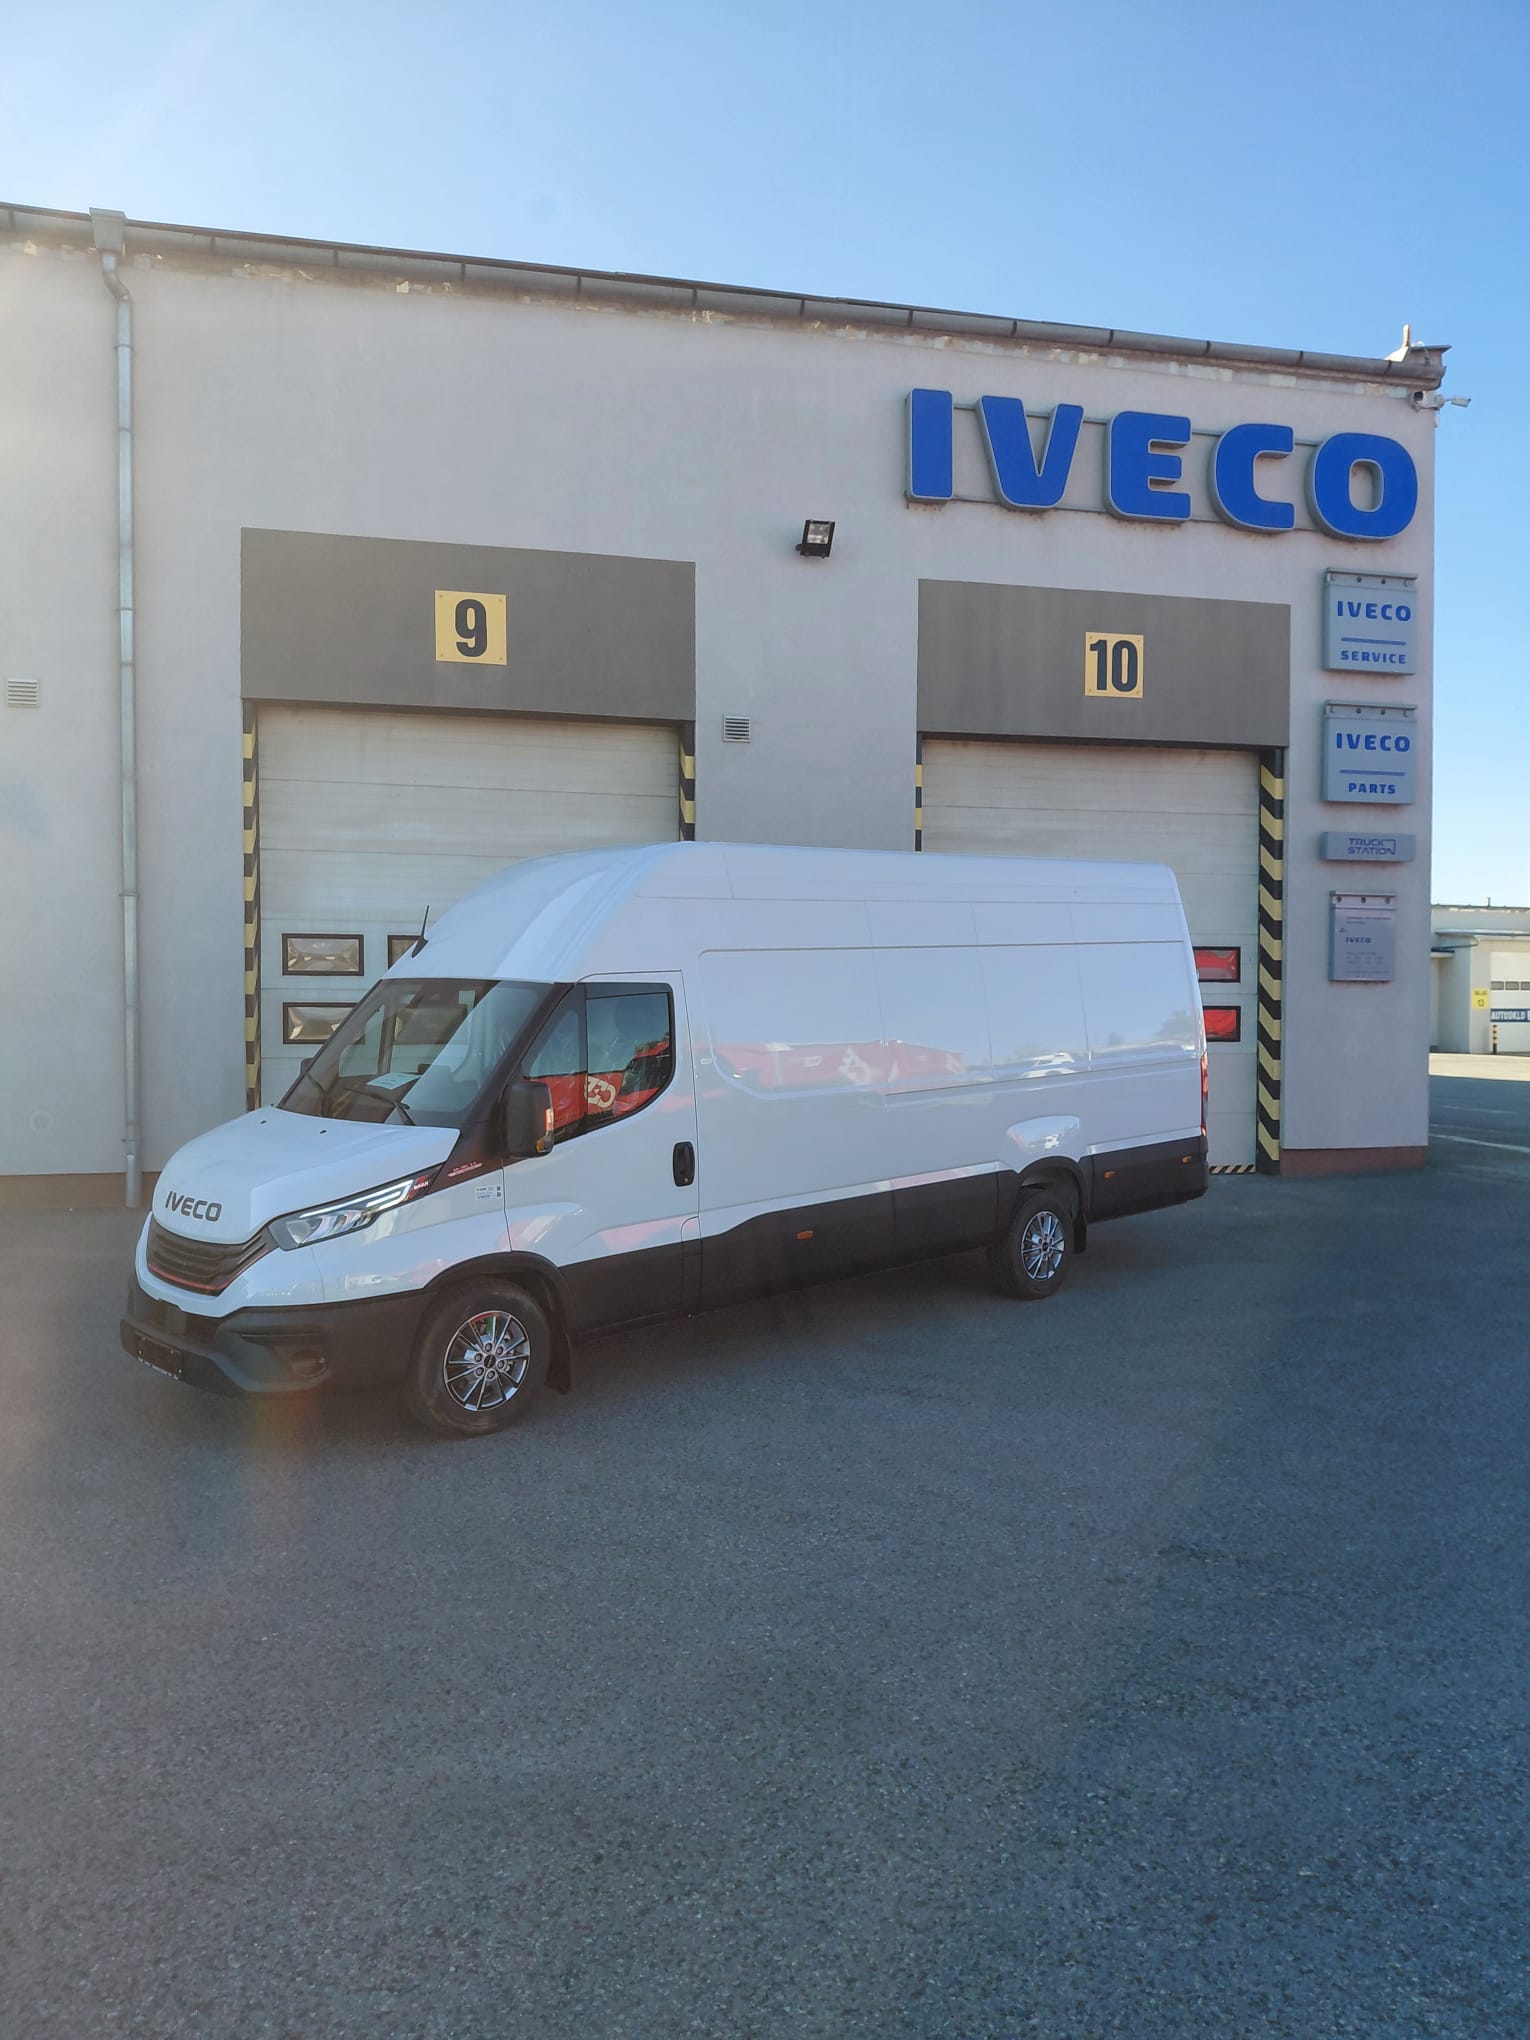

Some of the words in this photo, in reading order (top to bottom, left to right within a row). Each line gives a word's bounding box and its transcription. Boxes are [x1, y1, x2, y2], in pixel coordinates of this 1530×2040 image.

[908, 388, 1418, 542] IVECO
[1337, 600, 1412, 622] IVECO
[454, 598, 488, 658] 9
[1089, 638, 1139, 692] 10
[1340, 650, 1407, 665] SERVICE
[1336, 732, 1411, 753] IVECO
[1348, 782, 1396, 795] PARTS
[1347, 847, 1396, 855] STATION
[1348, 837, 1385, 846] TRUCK
[1344, 936, 1372, 944] IVECO
[165, 1190, 223, 1223] IVECO
